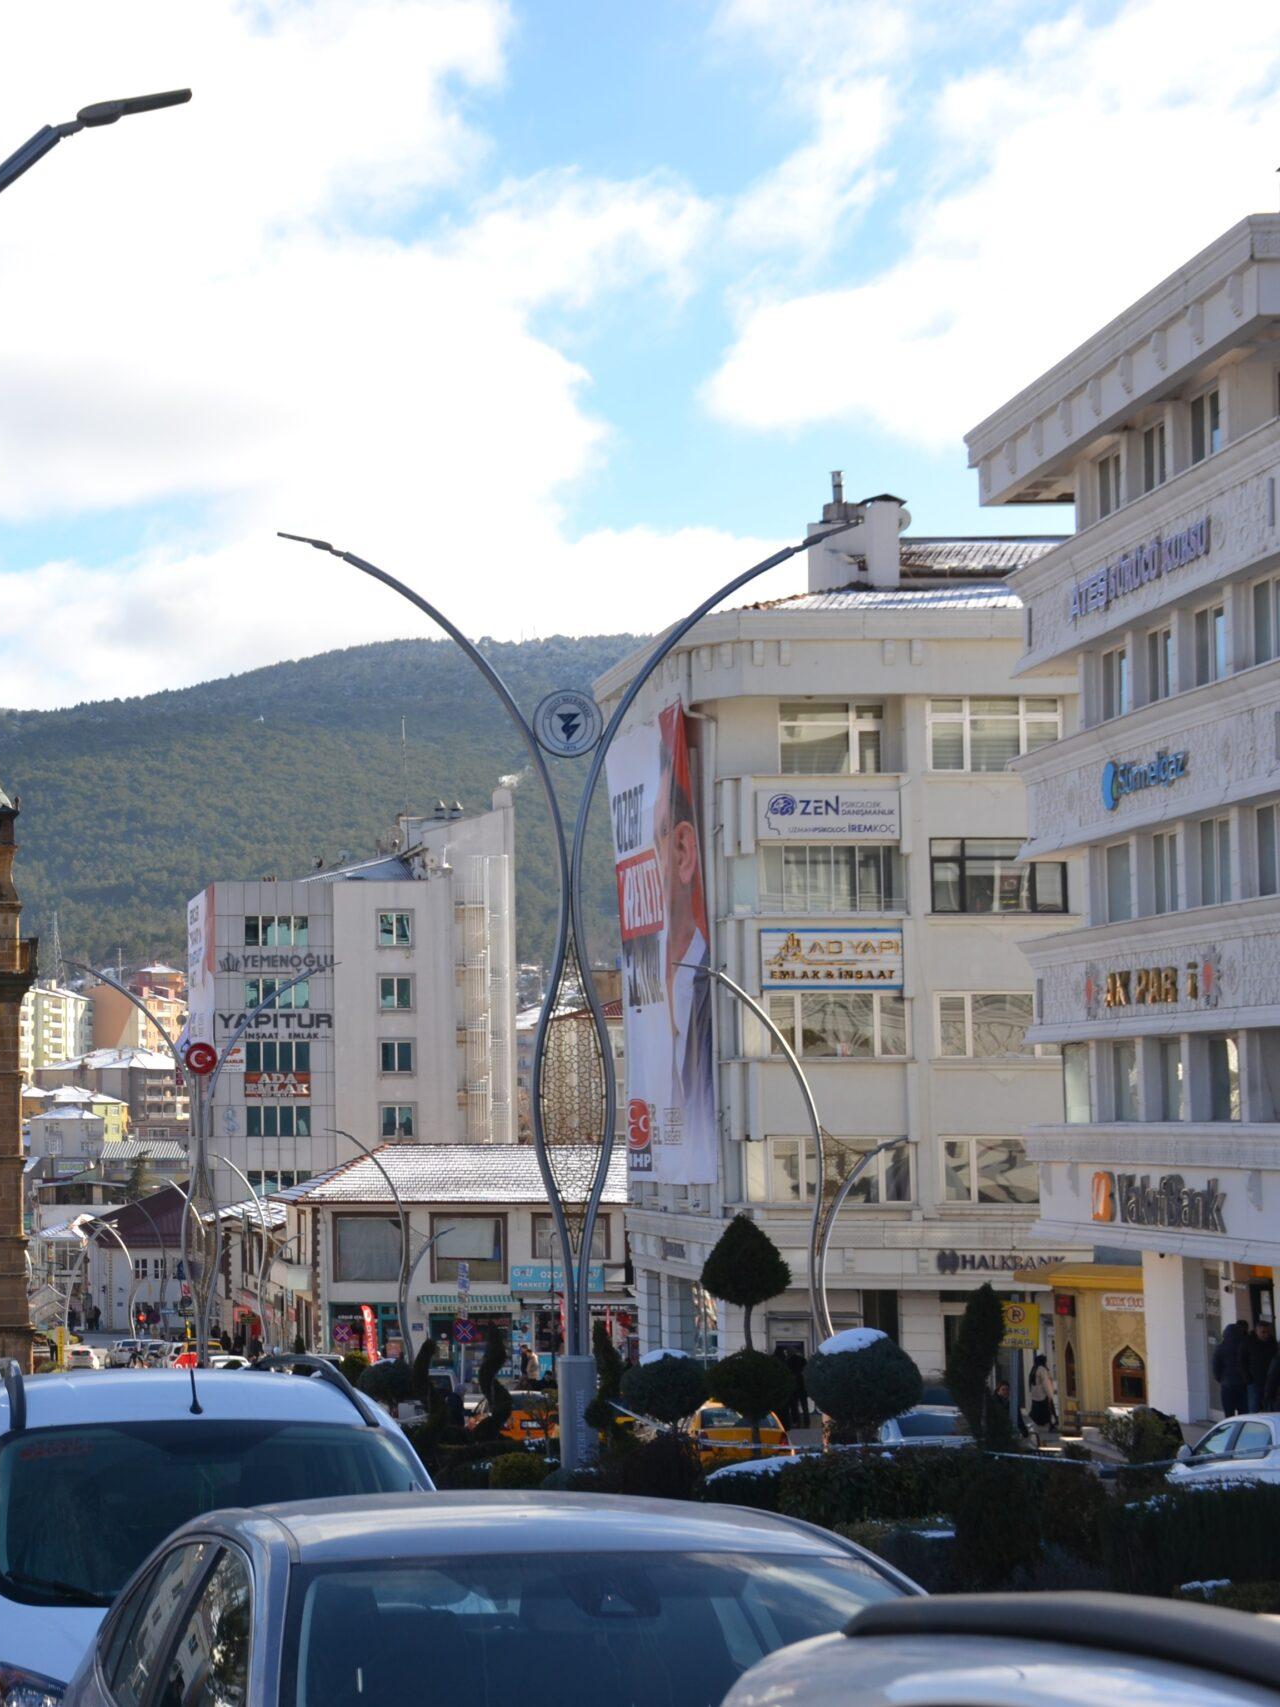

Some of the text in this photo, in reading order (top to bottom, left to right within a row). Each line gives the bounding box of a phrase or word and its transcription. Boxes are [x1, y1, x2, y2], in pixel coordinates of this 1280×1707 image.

[799, 795, 839, 815] ZEN
[847, 940, 900, 954] YAPI
[771, 970, 820, 980] EMLAK
[839, 967, 895, 982] İNŞAAT
[1105, 970, 1131, 1008] AK
[218, 1013, 333, 1029] YAPITUR
[244, 1030, 279, 1040] İNŞAAT
[258, 1073, 298, 1084] ADA
[245, 1083, 310, 1094] EMLAK
